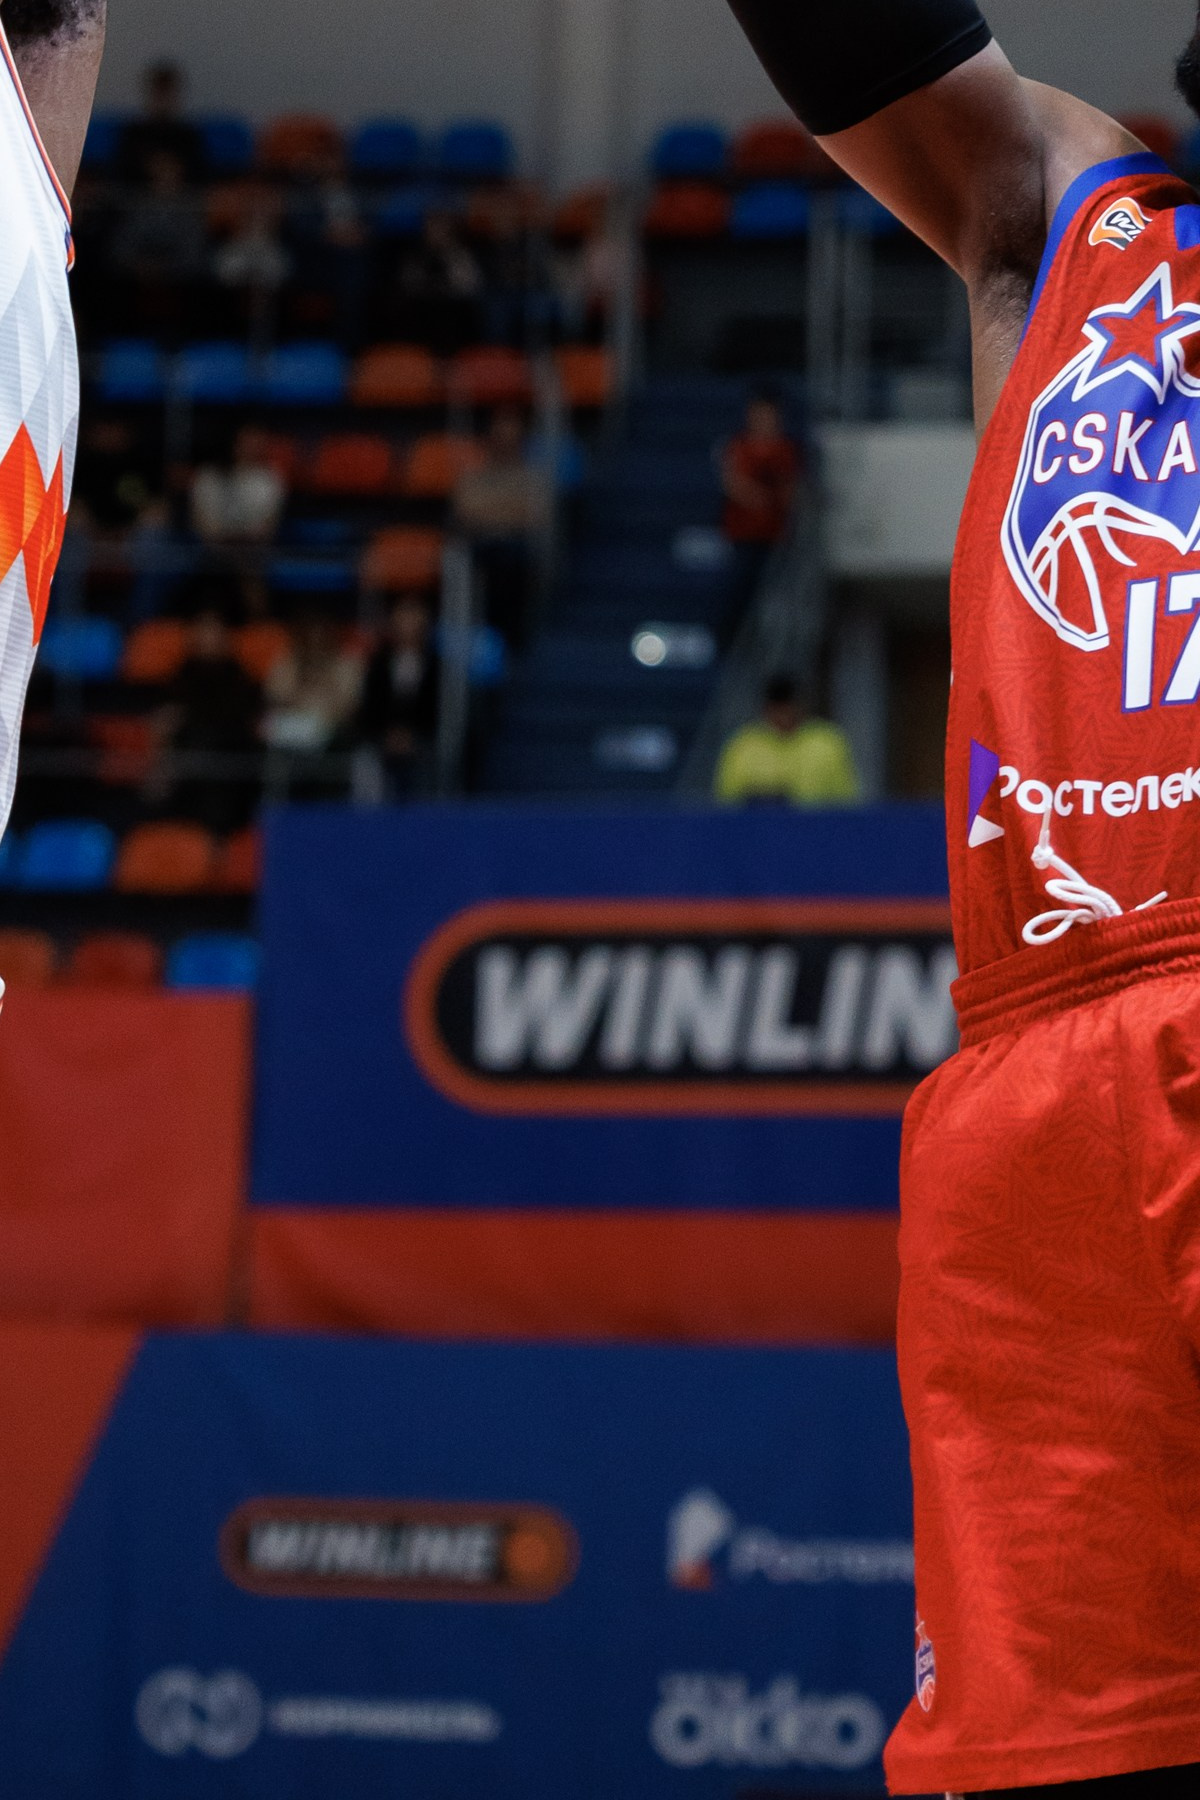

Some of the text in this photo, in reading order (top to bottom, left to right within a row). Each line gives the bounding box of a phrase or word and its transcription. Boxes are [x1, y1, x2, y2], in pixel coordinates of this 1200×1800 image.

[1032, 409, 1198, 485] CSKA
[1120, 569, 1200, 714] 17
[247, 1519, 497, 1584] WINLINE
